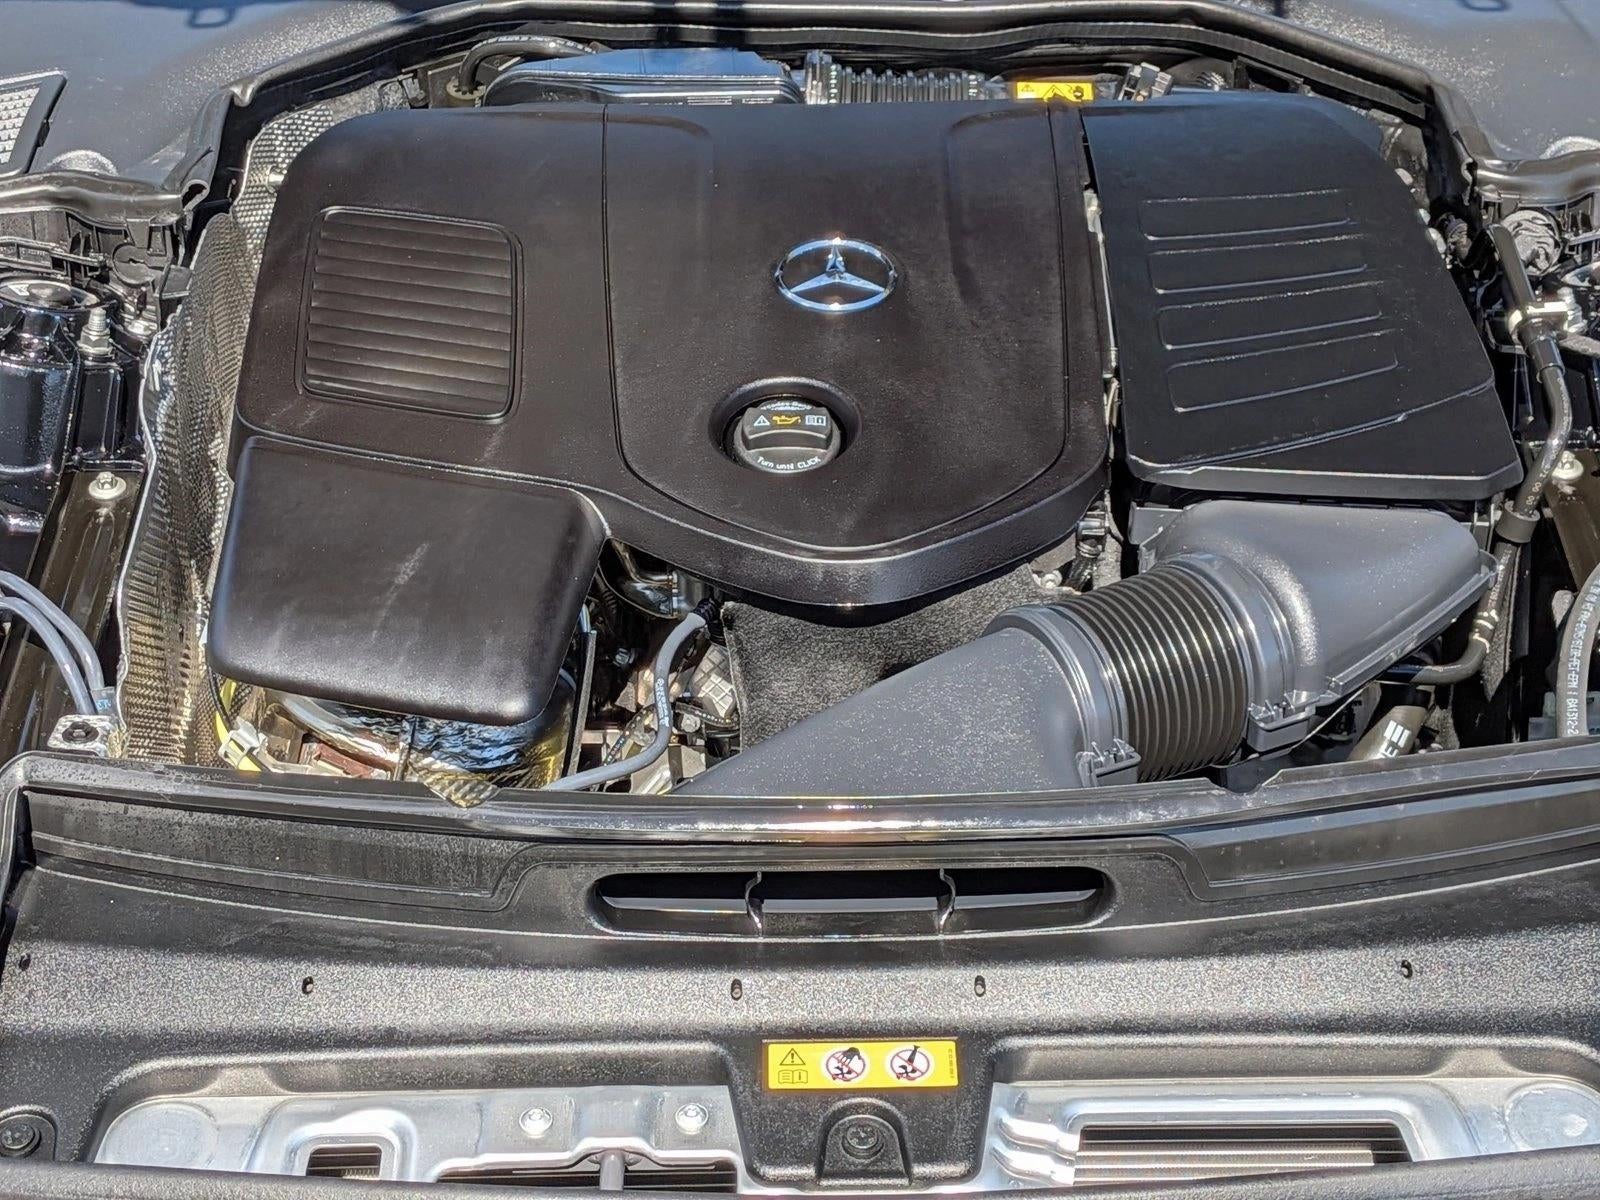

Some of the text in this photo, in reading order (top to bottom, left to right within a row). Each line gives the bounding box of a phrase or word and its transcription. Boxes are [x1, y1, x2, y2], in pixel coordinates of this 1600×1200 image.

[757, 456, 821, 470] Turn until CLICK
